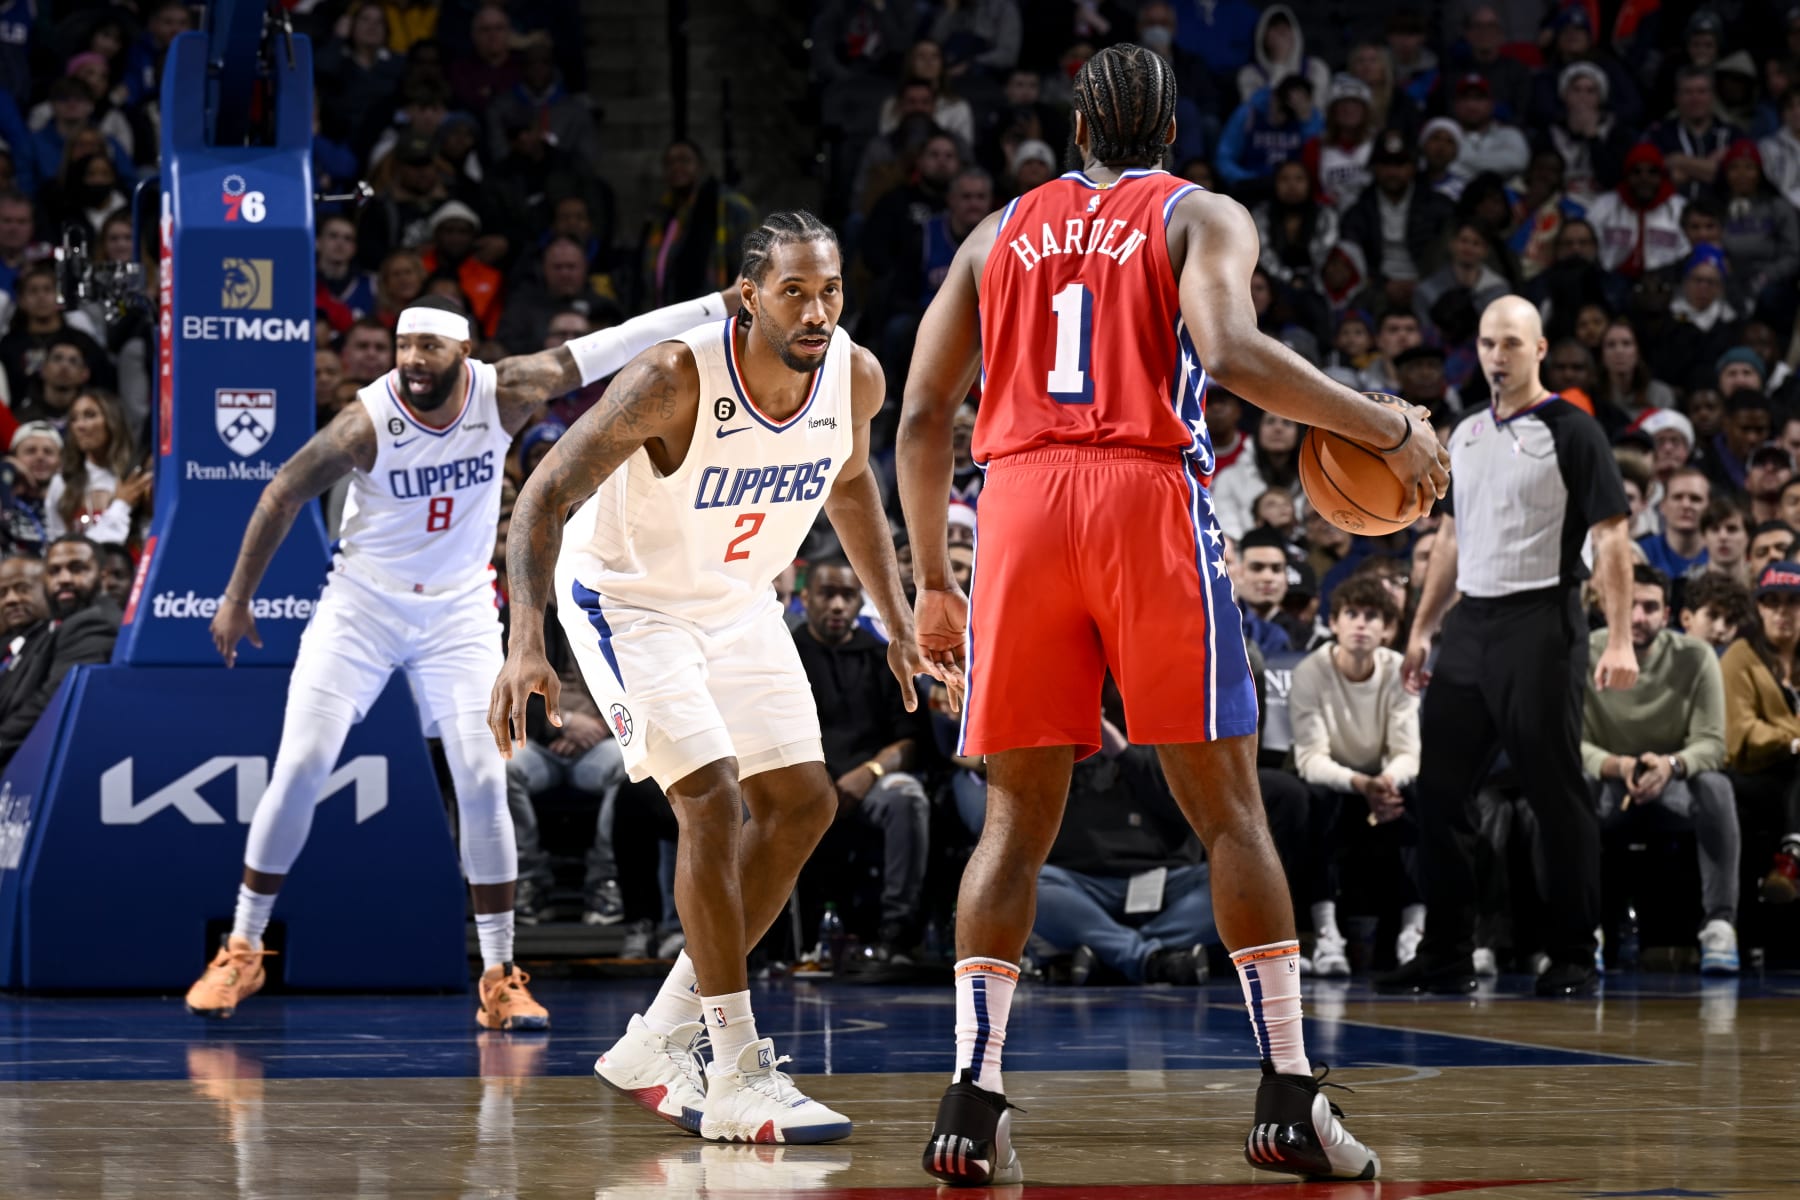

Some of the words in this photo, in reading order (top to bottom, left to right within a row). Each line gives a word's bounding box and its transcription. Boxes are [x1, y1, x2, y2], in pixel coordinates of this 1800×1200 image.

[222, 190, 266, 222] 76
[1009, 218, 1147, 271] HARDEN
[183, 316, 310, 342] BETMGM
[1047, 283, 1094, 404] 1
[718, 401, 731, 418] 6
[808, 416, 838, 430] honey
[186, 460, 226, 480] Penn
[228, 460, 279, 480] Medic
[388, 450, 494, 499] CLIPPERS
[694, 457, 832, 509] CLIPPERS
[426, 497, 454, 533] 8
[724, 513, 766, 563] 2
[153, 590, 319, 619] tickeaste
